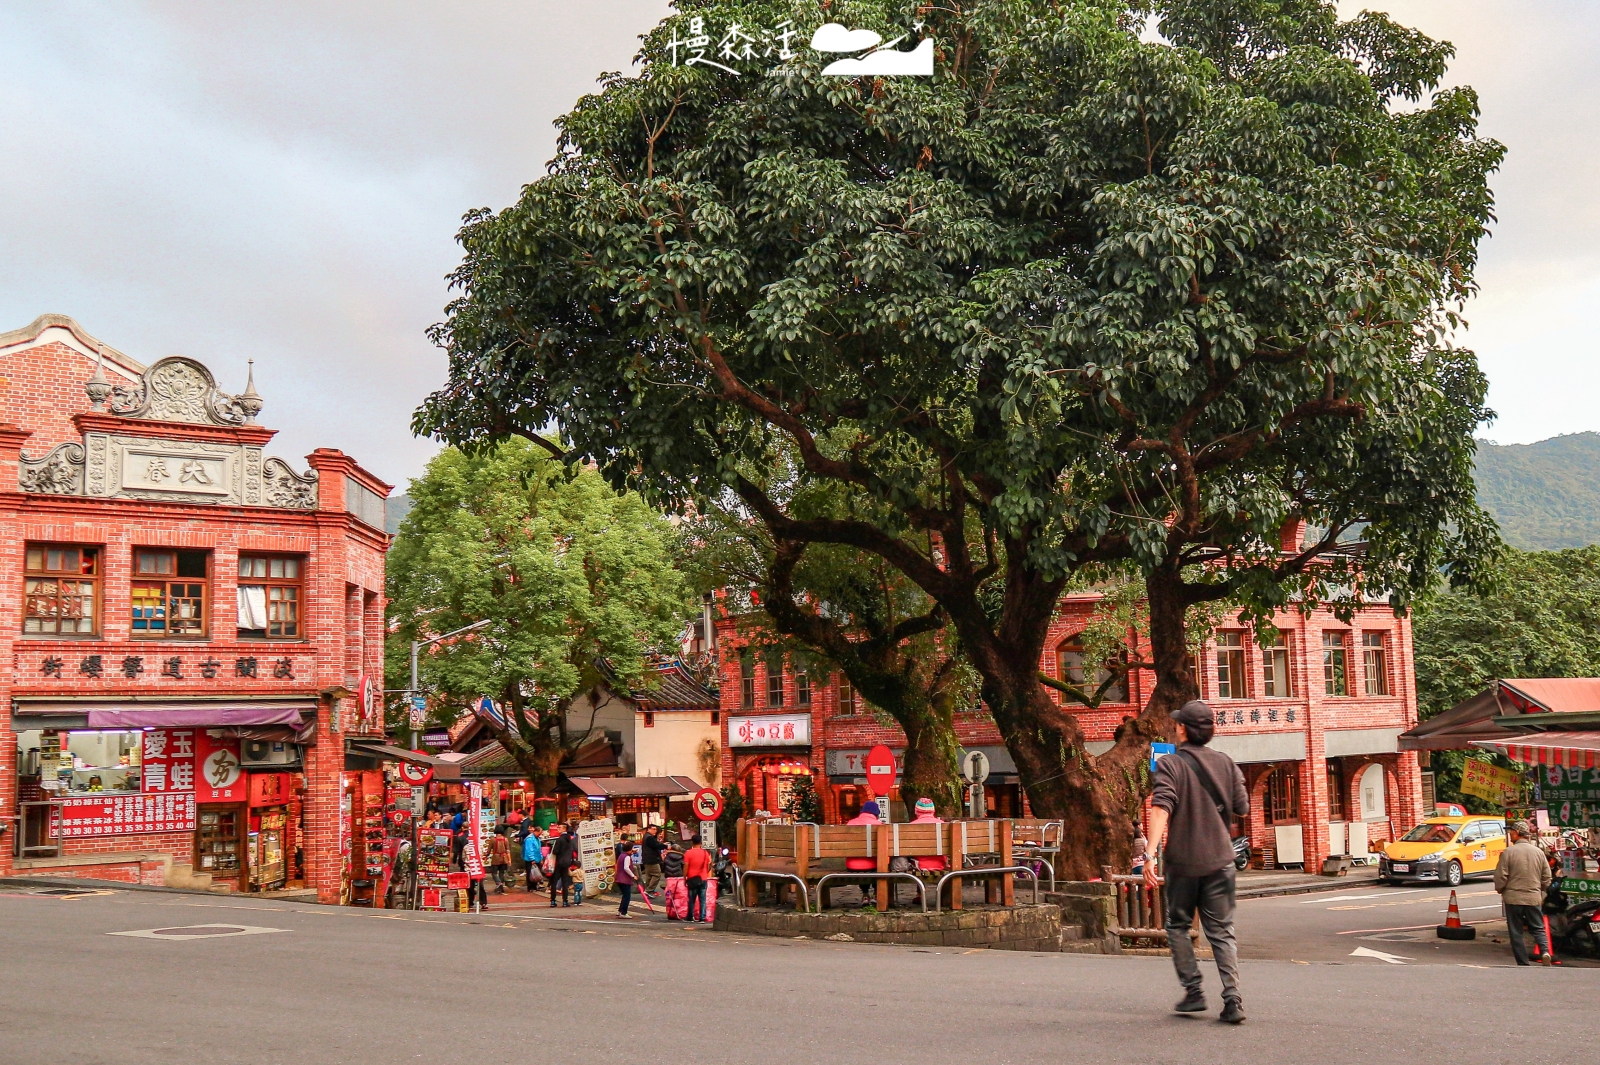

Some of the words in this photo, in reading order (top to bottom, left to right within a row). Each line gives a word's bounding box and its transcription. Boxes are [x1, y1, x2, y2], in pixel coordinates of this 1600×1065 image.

[739, 720, 794, 743] 味の豆腐
[144, 731, 194, 760] 愛玉
[144, 762, 194, 791] 青蛙
[211, 789, 232, 798] 豆腐
[104, 826, 112, 834] 30
[125, 824, 133, 832] 35
[145, 823, 153, 831] 35
[166, 822, 174, 830] 35
